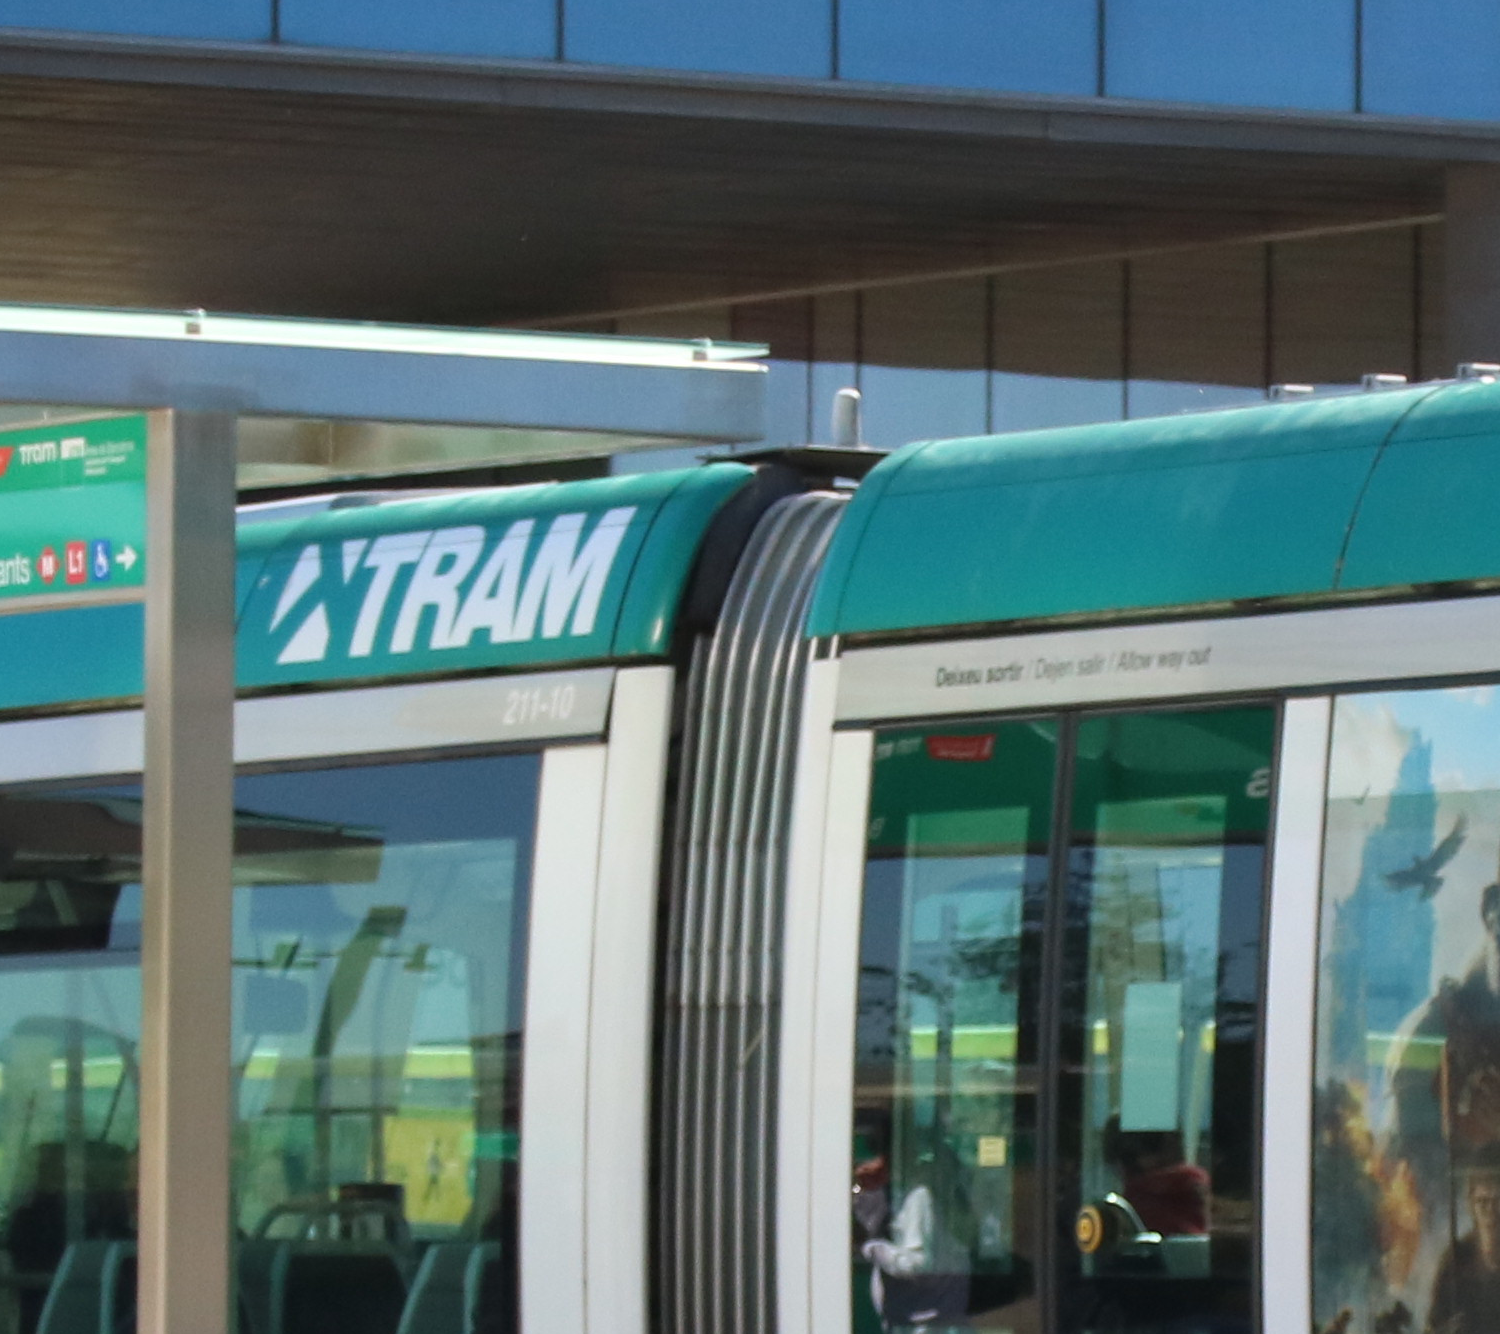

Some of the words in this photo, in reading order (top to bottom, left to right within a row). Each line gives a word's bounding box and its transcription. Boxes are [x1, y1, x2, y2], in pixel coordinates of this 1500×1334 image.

[67, 549, 84, 575] L1
[348, 506, 638, 658] TRAM
[502, 683, 575, 726] 211-10
